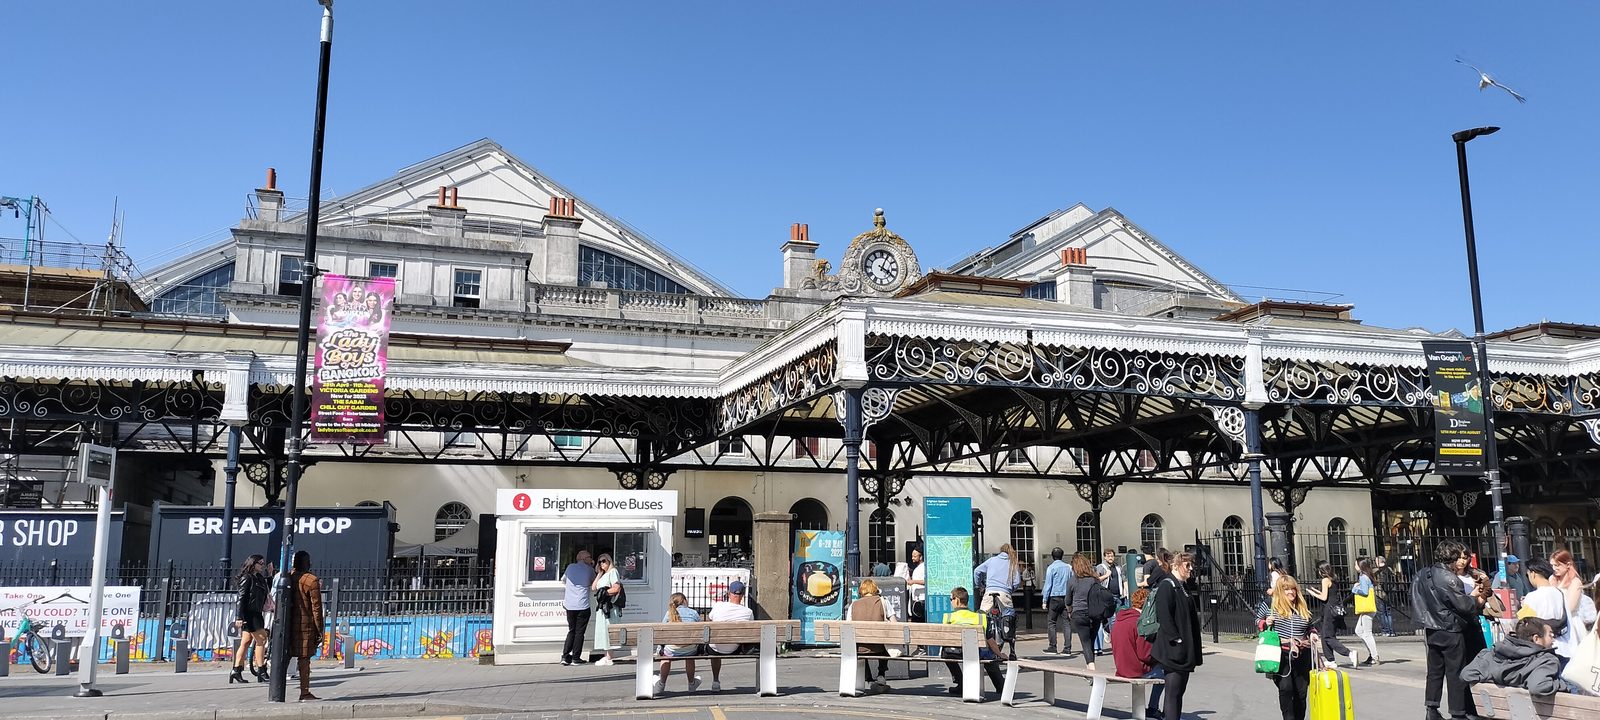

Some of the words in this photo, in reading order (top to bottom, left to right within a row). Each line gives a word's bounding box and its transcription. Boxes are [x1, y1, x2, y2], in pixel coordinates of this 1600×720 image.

[324, 332, 377, 352] Lady
[325, 350, 375, 367] Boys
[321, 367, 379, 380] BANGKOK
[542, 496, 592, 512] Brighton
[598, 498, 626, 509] Hove
[629, 498, 663, 510] Buses
[12, 519, 78, 546] SHOP
[188, 517, 276, 535] BREAD
[833, 540, 842, 549] MAY
[831, 548, 842, 557] 2023
[111, 608, 133, 616] ONE
[75, 619, 107, 627] LEE
[110, 619, 132, 627] ONE
